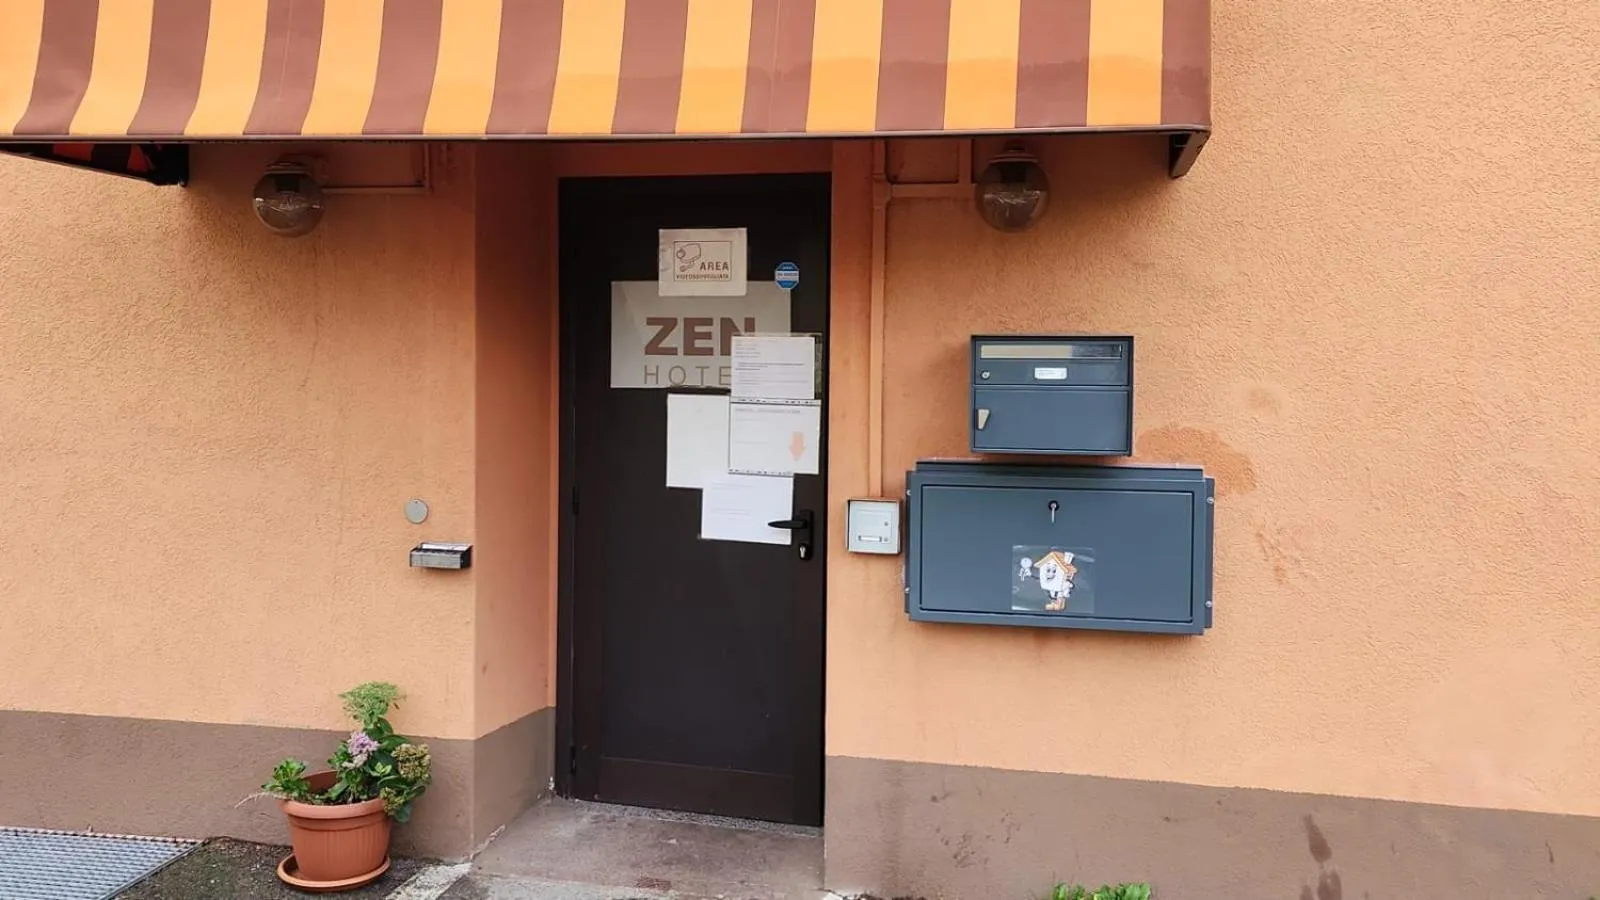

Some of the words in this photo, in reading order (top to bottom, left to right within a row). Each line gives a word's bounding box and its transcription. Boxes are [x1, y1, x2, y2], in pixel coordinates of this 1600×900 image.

[700, 261, 729, 271] AREA
[644, 317, 756, 356] ZEN
[644, 365, 731, 386] HOTE
